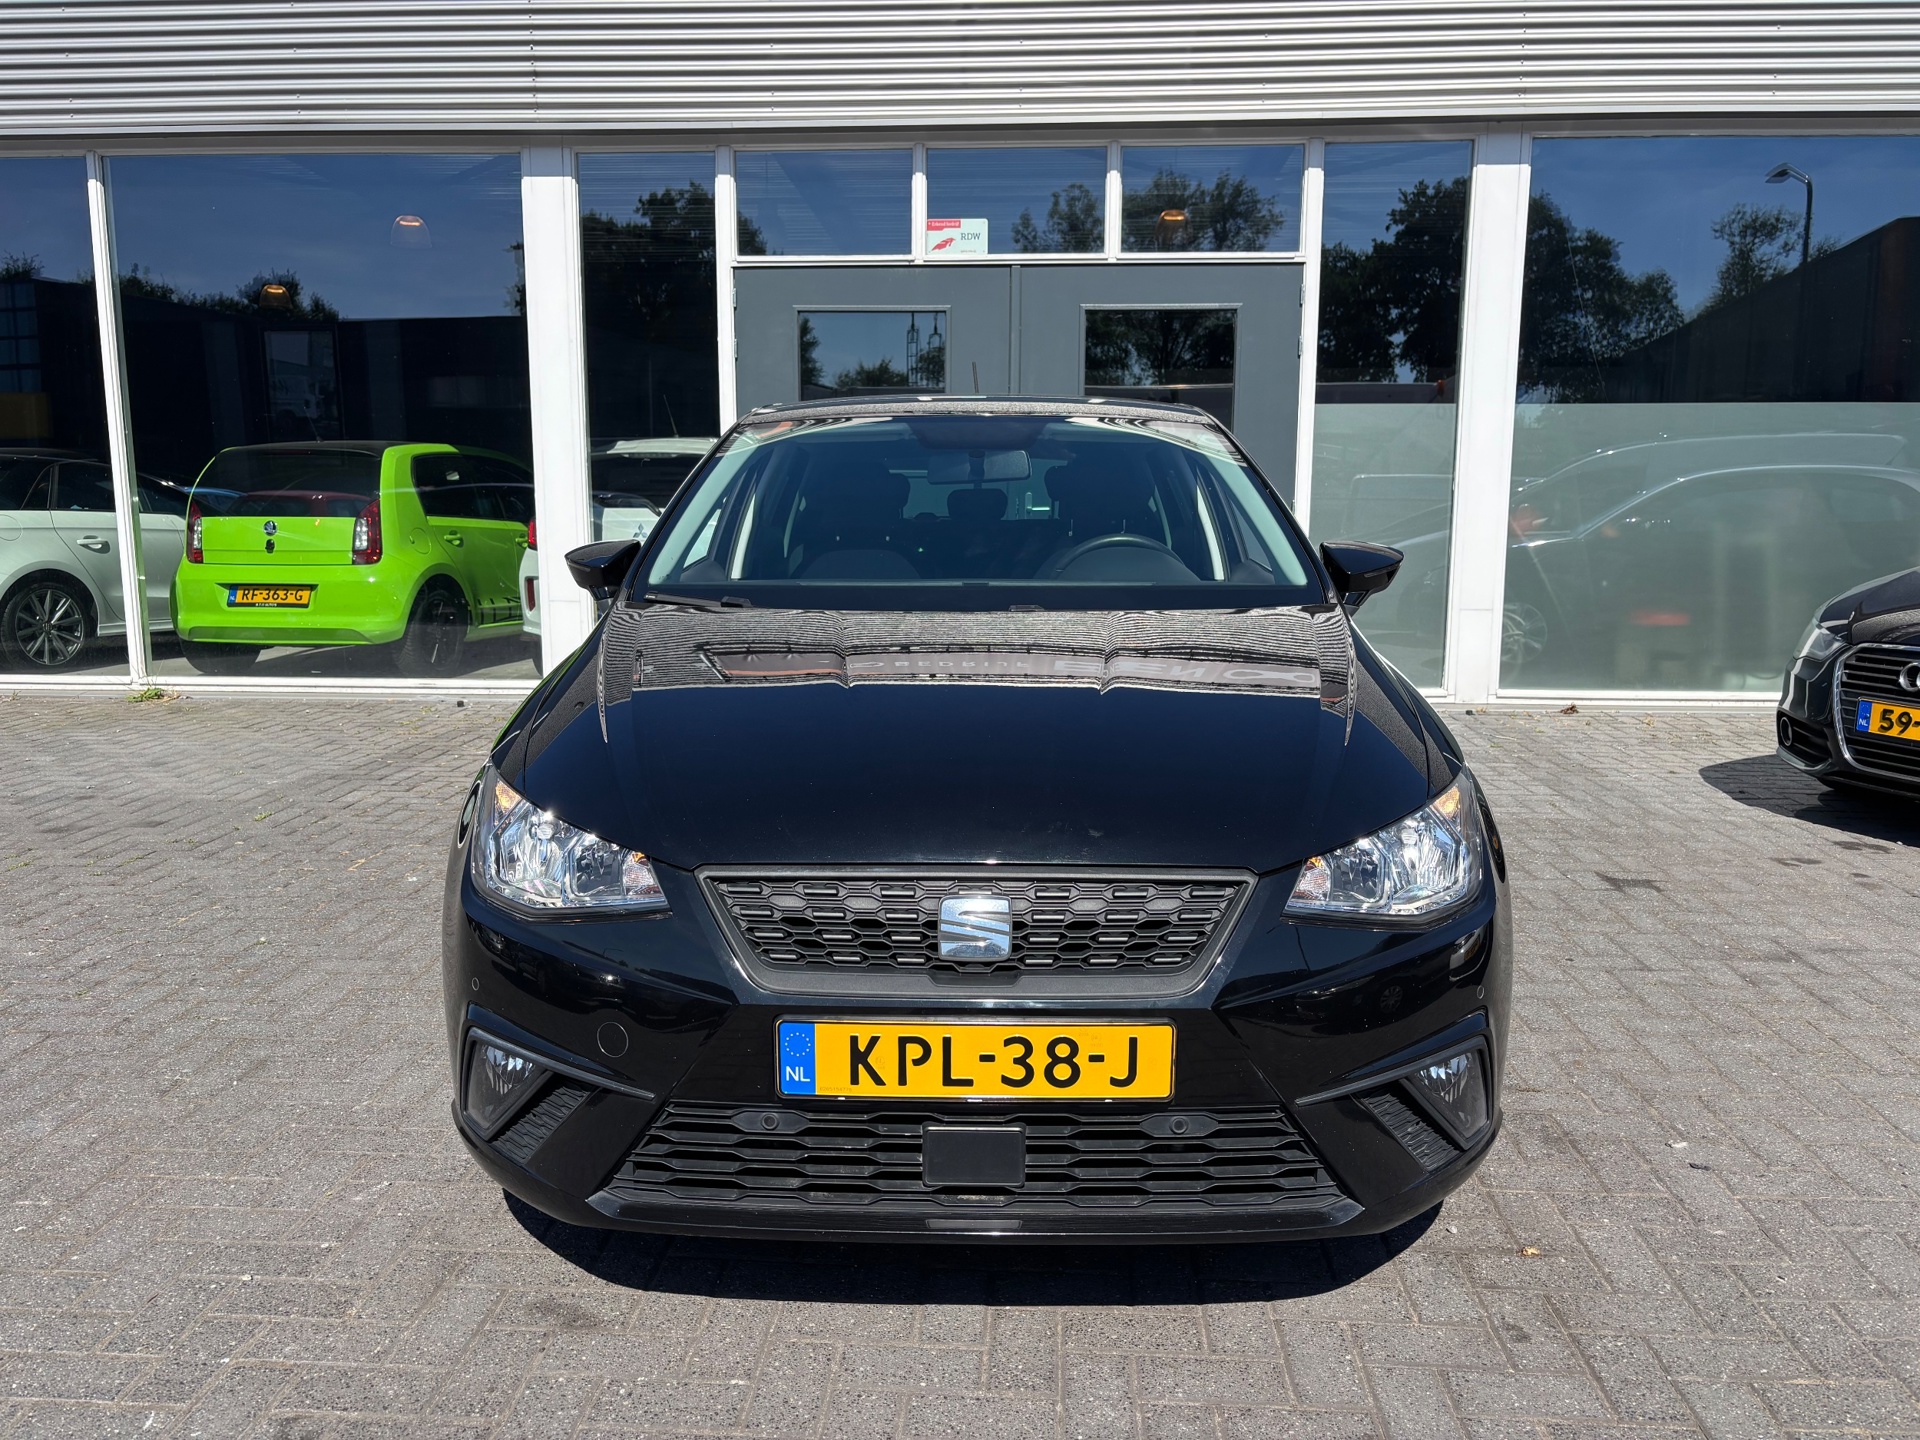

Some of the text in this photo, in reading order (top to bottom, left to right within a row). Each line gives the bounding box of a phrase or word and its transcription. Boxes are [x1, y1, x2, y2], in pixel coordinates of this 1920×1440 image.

[960, 232, 981, 241] RDW
[241, 588, 303, 601] RF-363-G
[1858, 718, 1869, 727] NL
[849, 1034, 1138, 1088] KPL-38-J
[785, 1066, 811, 1083] NL
